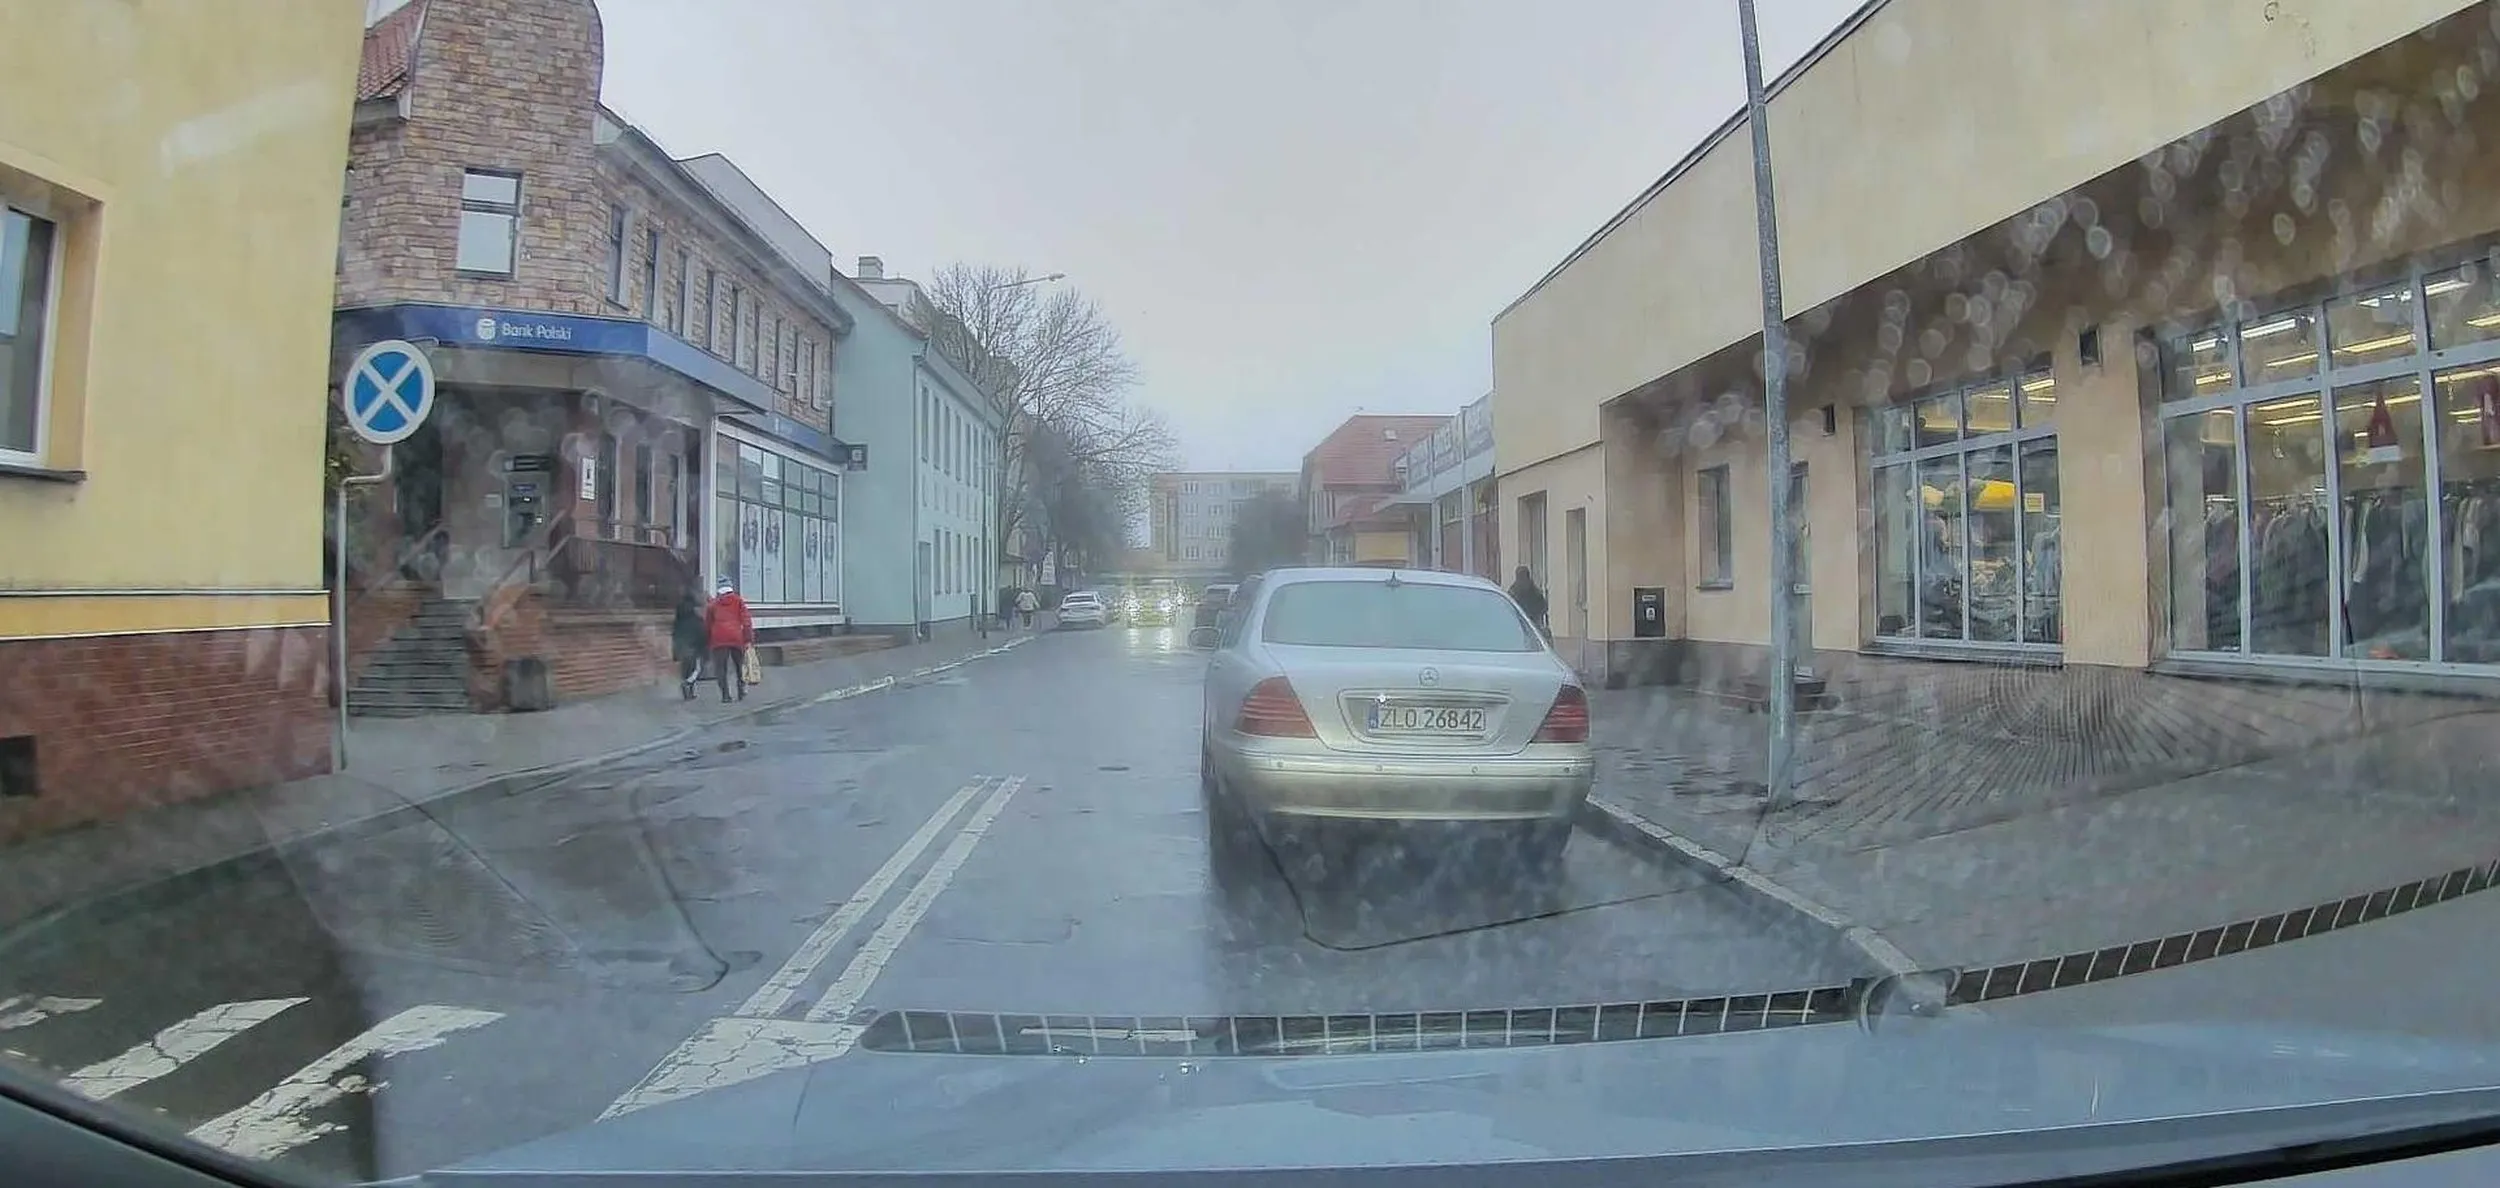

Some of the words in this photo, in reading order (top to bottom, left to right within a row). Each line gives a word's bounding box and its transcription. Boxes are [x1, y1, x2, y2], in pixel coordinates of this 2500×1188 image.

[502, 322, 533, 338] Bank
[536, 324, 571, 340] Polski
[1380, 708, 1417, 728] ZLO
[1423, 709, 1482, 731] 26842
